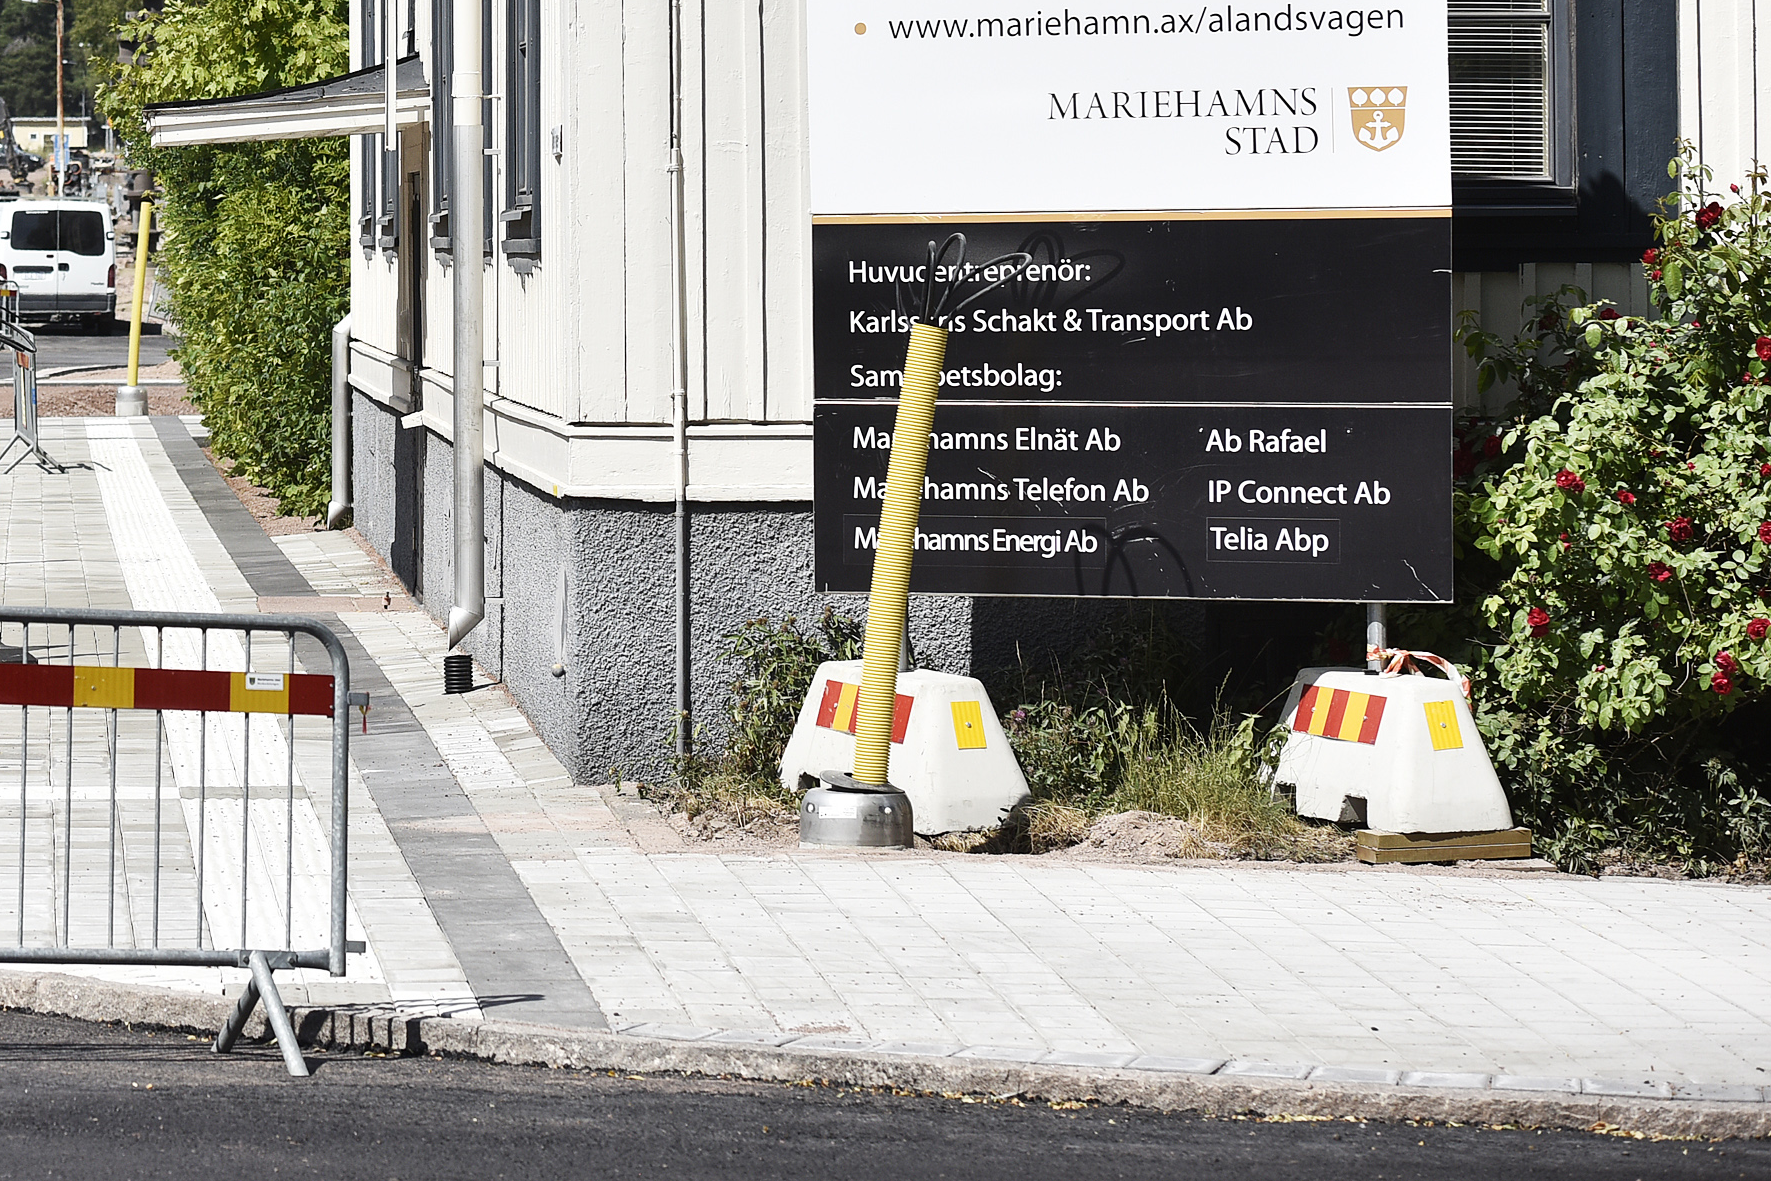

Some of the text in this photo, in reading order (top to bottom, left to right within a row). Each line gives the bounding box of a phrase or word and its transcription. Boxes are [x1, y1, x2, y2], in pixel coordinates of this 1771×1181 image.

[888, 3, 1404, 39] www.mariehamn.ax/alandsvagen
[1048, 87, 1317, 120] MARIEHAMNS
[1225, 126, 1319, 156] STAD
[972, 308, 1057, 333] Schakt
[1063, 308, 1083, 332] &
[1085, 308, 1210, 337] Transport
[1216, 306, 1253, 331] Ab
[1015, 426, 1079, 451] Elnät
[1084, 427, 1121, 452] Ab
[1205, 428, 1327, 454] Ab Rafael
[853, 476, 1150, 503] Mahamns Telefon Ab
[1208, 479, 1391, 505] IP Connect Ab
[992, 528, 1062, 559] Energi
[1063, 529, 1098, 553] Ab
[1209, 526, 1329, 558] Telia Abp
